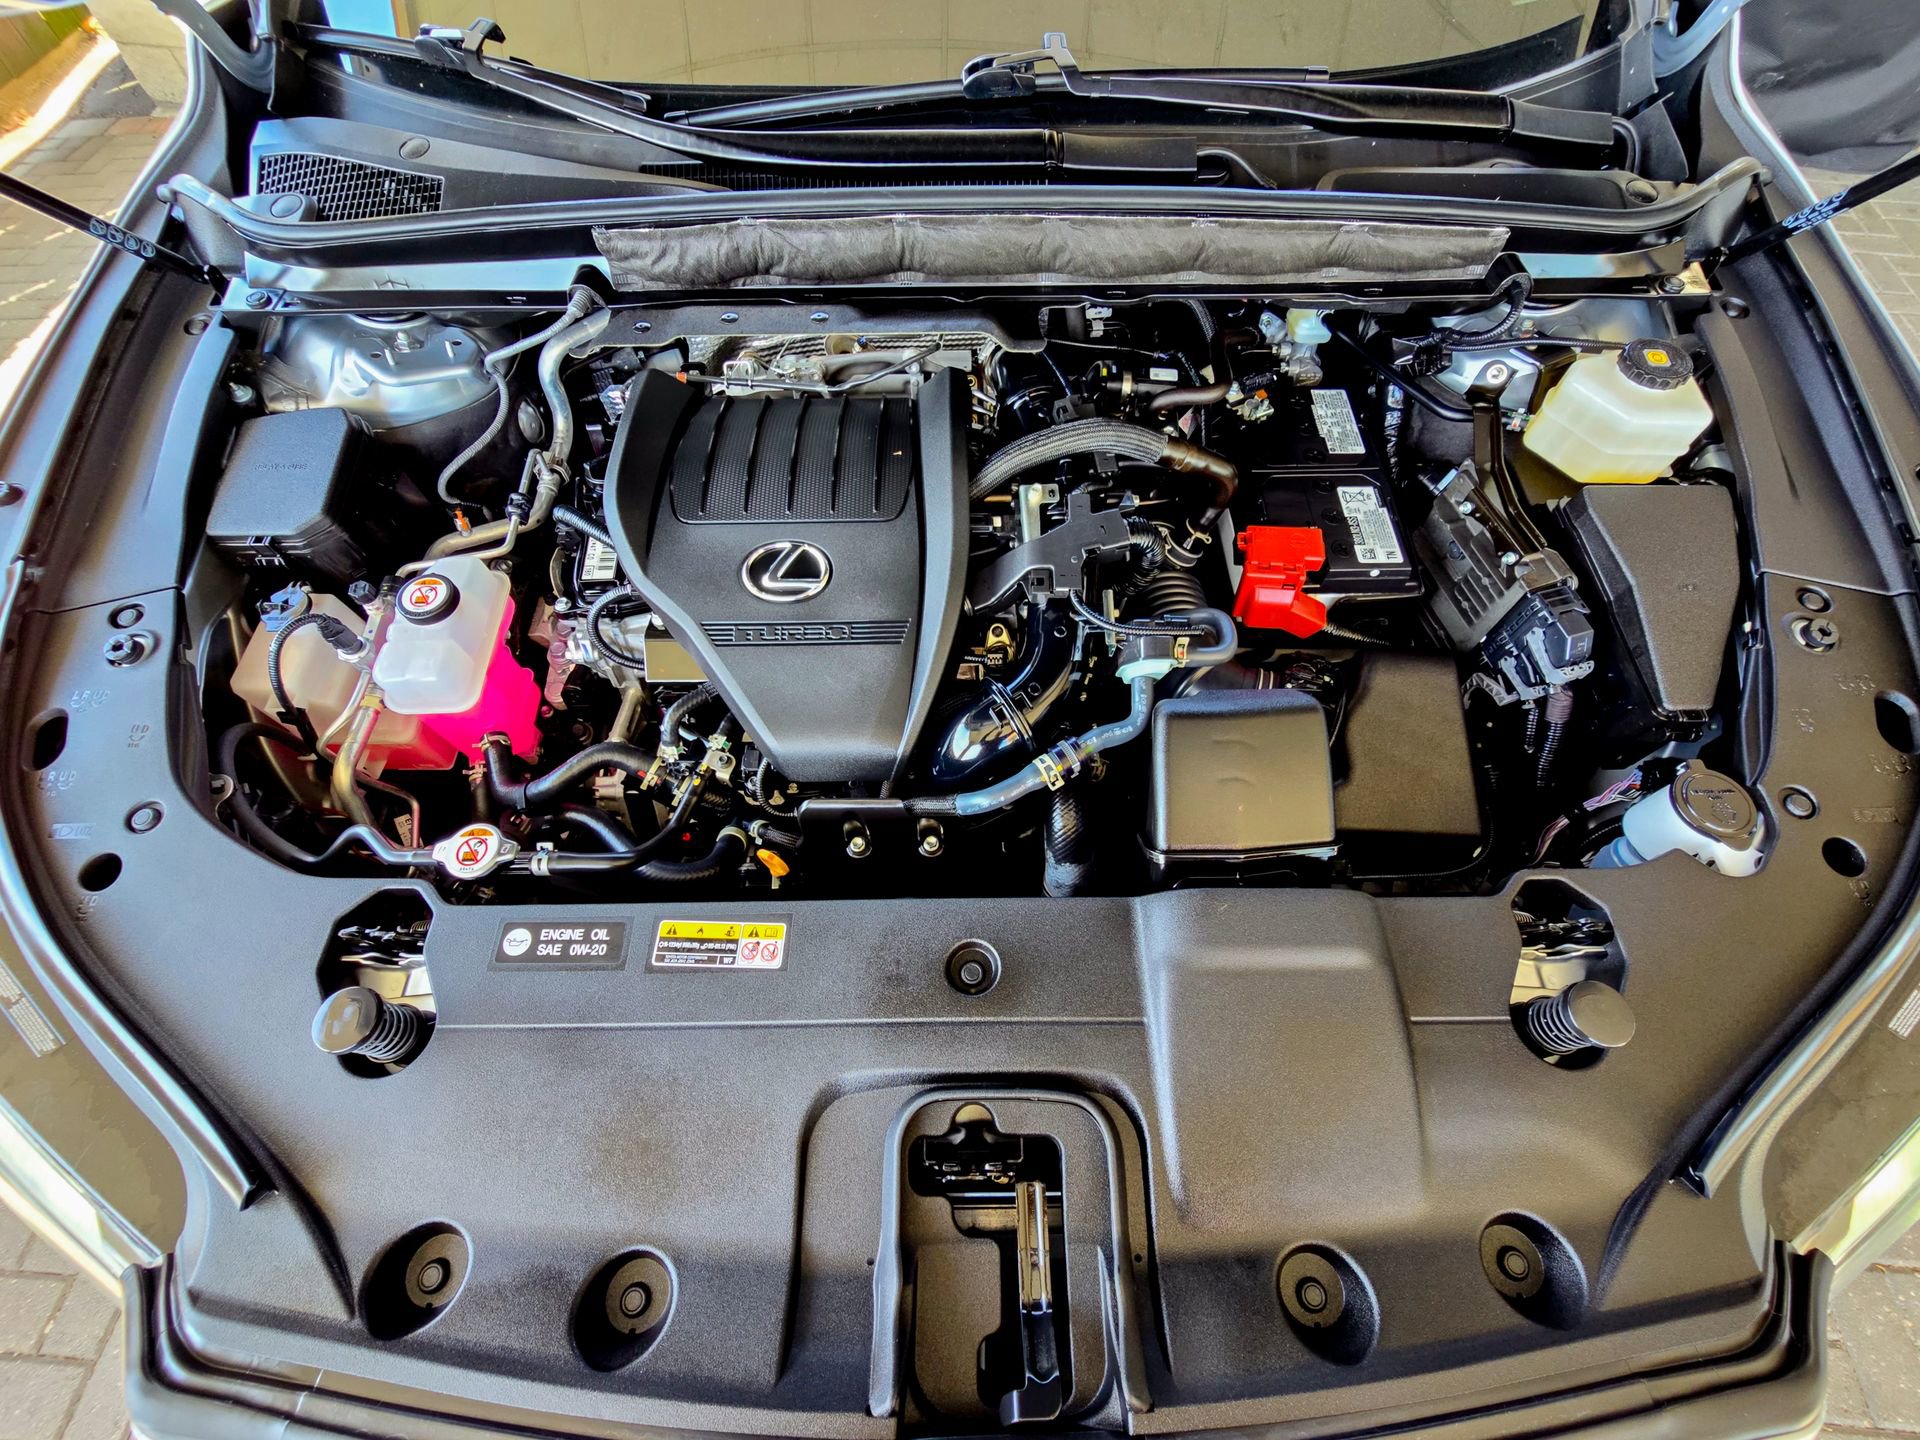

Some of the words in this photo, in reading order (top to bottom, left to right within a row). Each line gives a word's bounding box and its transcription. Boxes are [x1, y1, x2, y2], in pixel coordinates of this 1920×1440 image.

[737, 625, 850, 641] TURBO
[540, 929, 585, 940] ENGINE
[591, 929, 610, 940] OIL
[536, 943, 563, 955] SAE
[569, 943, 607, 955] 0W-20
